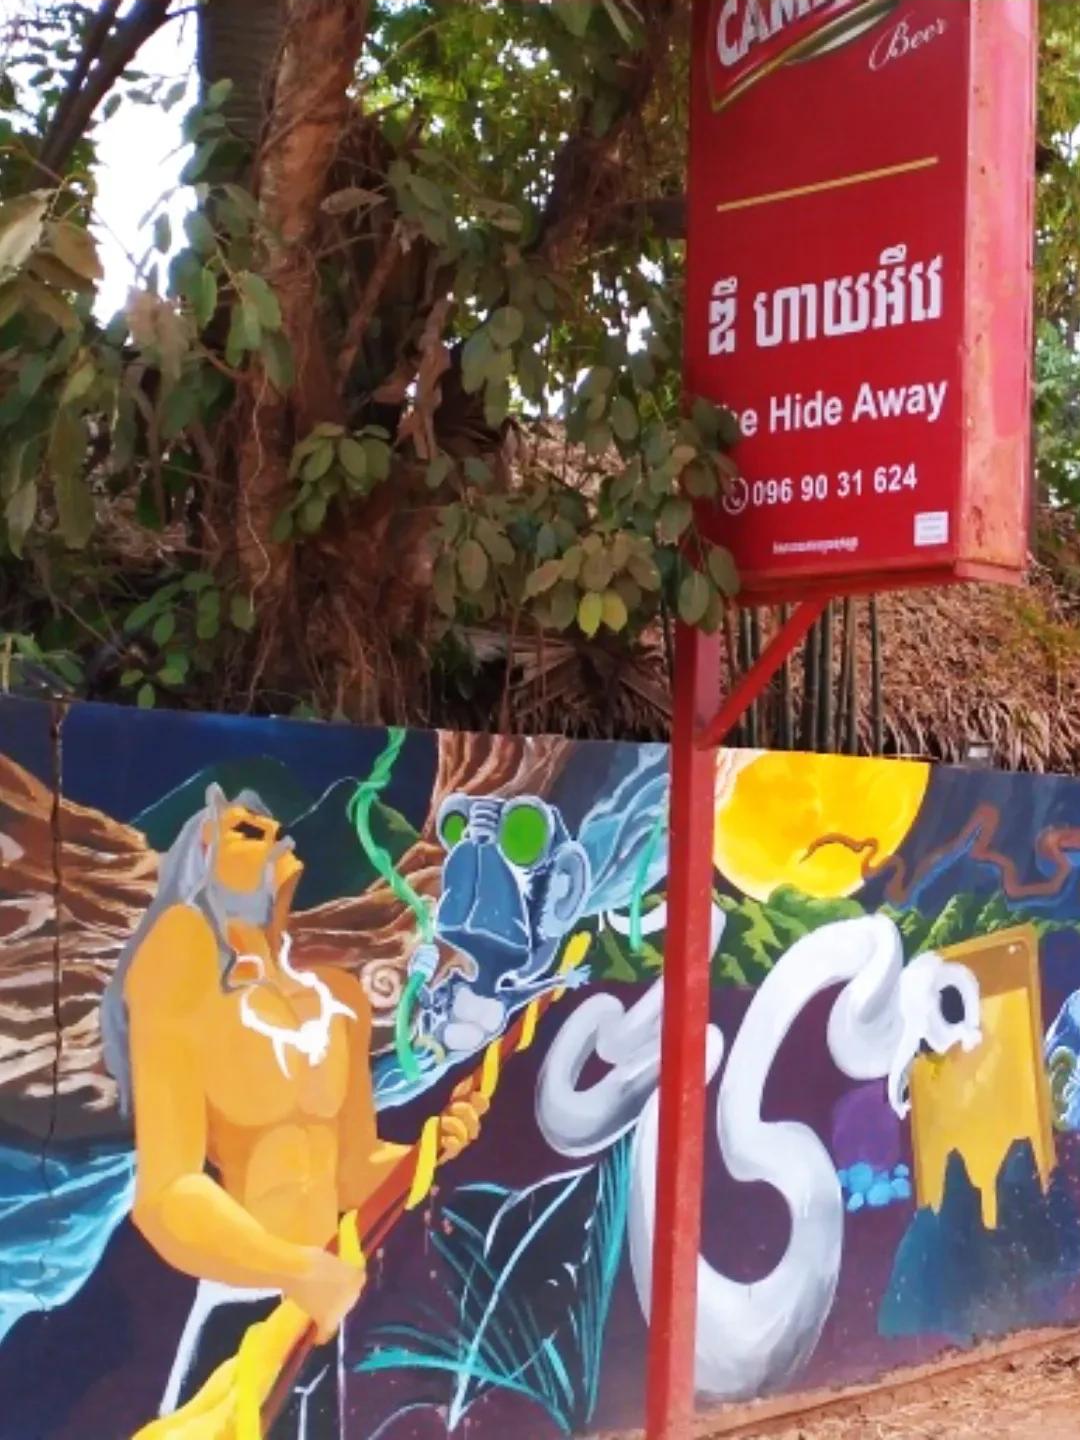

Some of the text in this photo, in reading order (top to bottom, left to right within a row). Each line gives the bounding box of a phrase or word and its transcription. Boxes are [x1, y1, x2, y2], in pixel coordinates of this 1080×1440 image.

[867, 10, 947, 72] Beer
[769, 389, 843, 433] Hide
[851, 379, 948, 423] Away
[752, 462, 918, 506] 096 90 31 624
